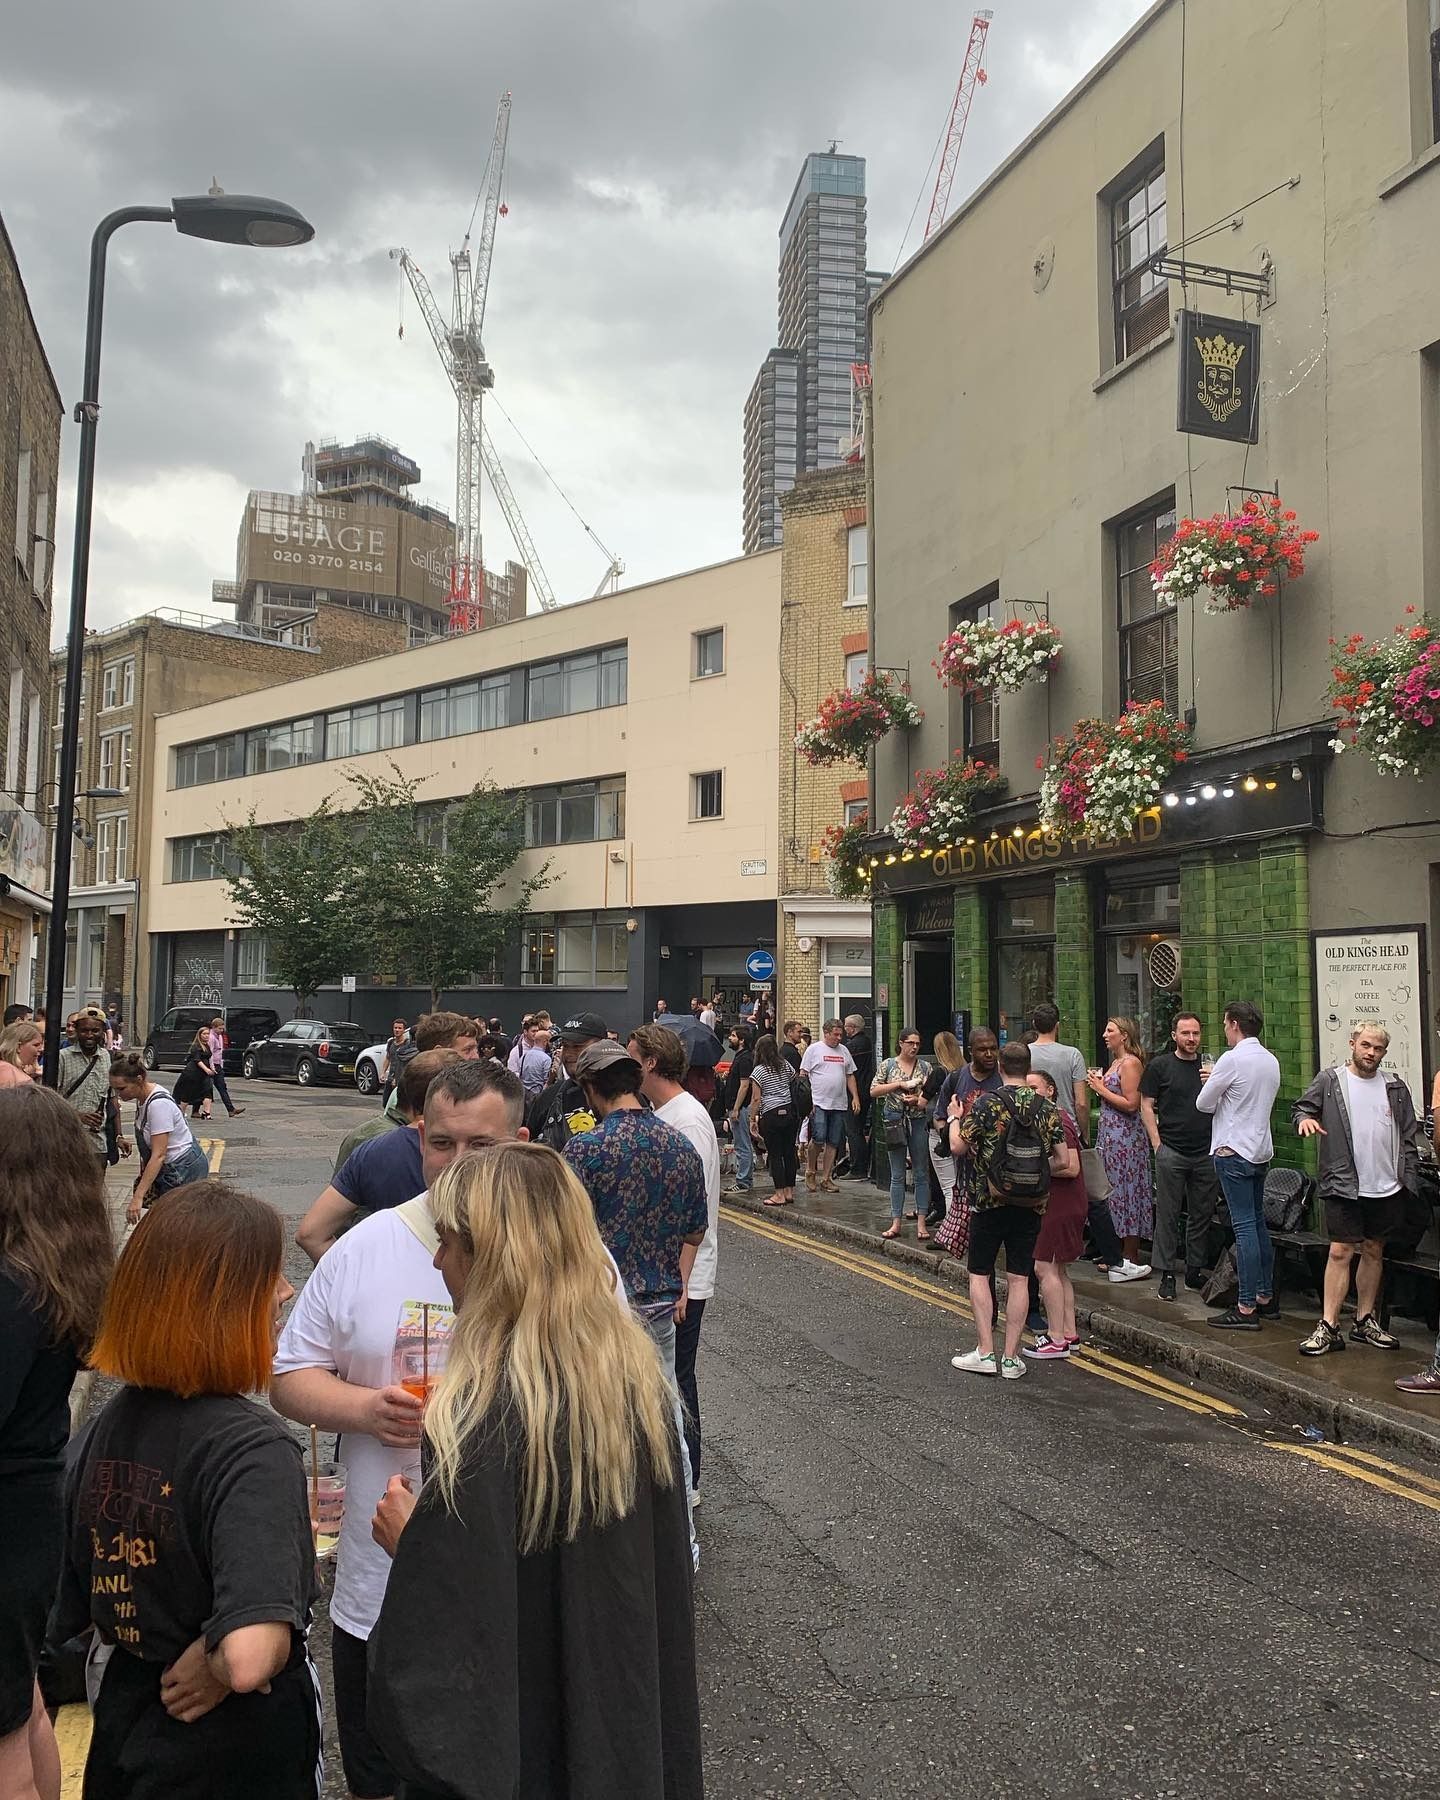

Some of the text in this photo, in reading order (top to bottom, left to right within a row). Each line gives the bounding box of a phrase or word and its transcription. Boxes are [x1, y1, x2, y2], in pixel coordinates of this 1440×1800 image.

[273, 550, 383, 573] 020 3770 2154
[932, 847, 976, 877] OLD
[984, 831, 1062, 868] KINGS
[916, 908, 954, 930] Welcom
[846, 949, 865, 960] 27
[1325, 945, 1409, 959] OLD KINGS HEAD
[1342, 964, 1371, 972] PERFECT
[1371, 963, 1392, 971] PLACE
[1393, 963, 1407, 971] FOR
[1354, 992, 1380, 1000] COFFEE
[1384, 1061, 1397, 1069] TEA
